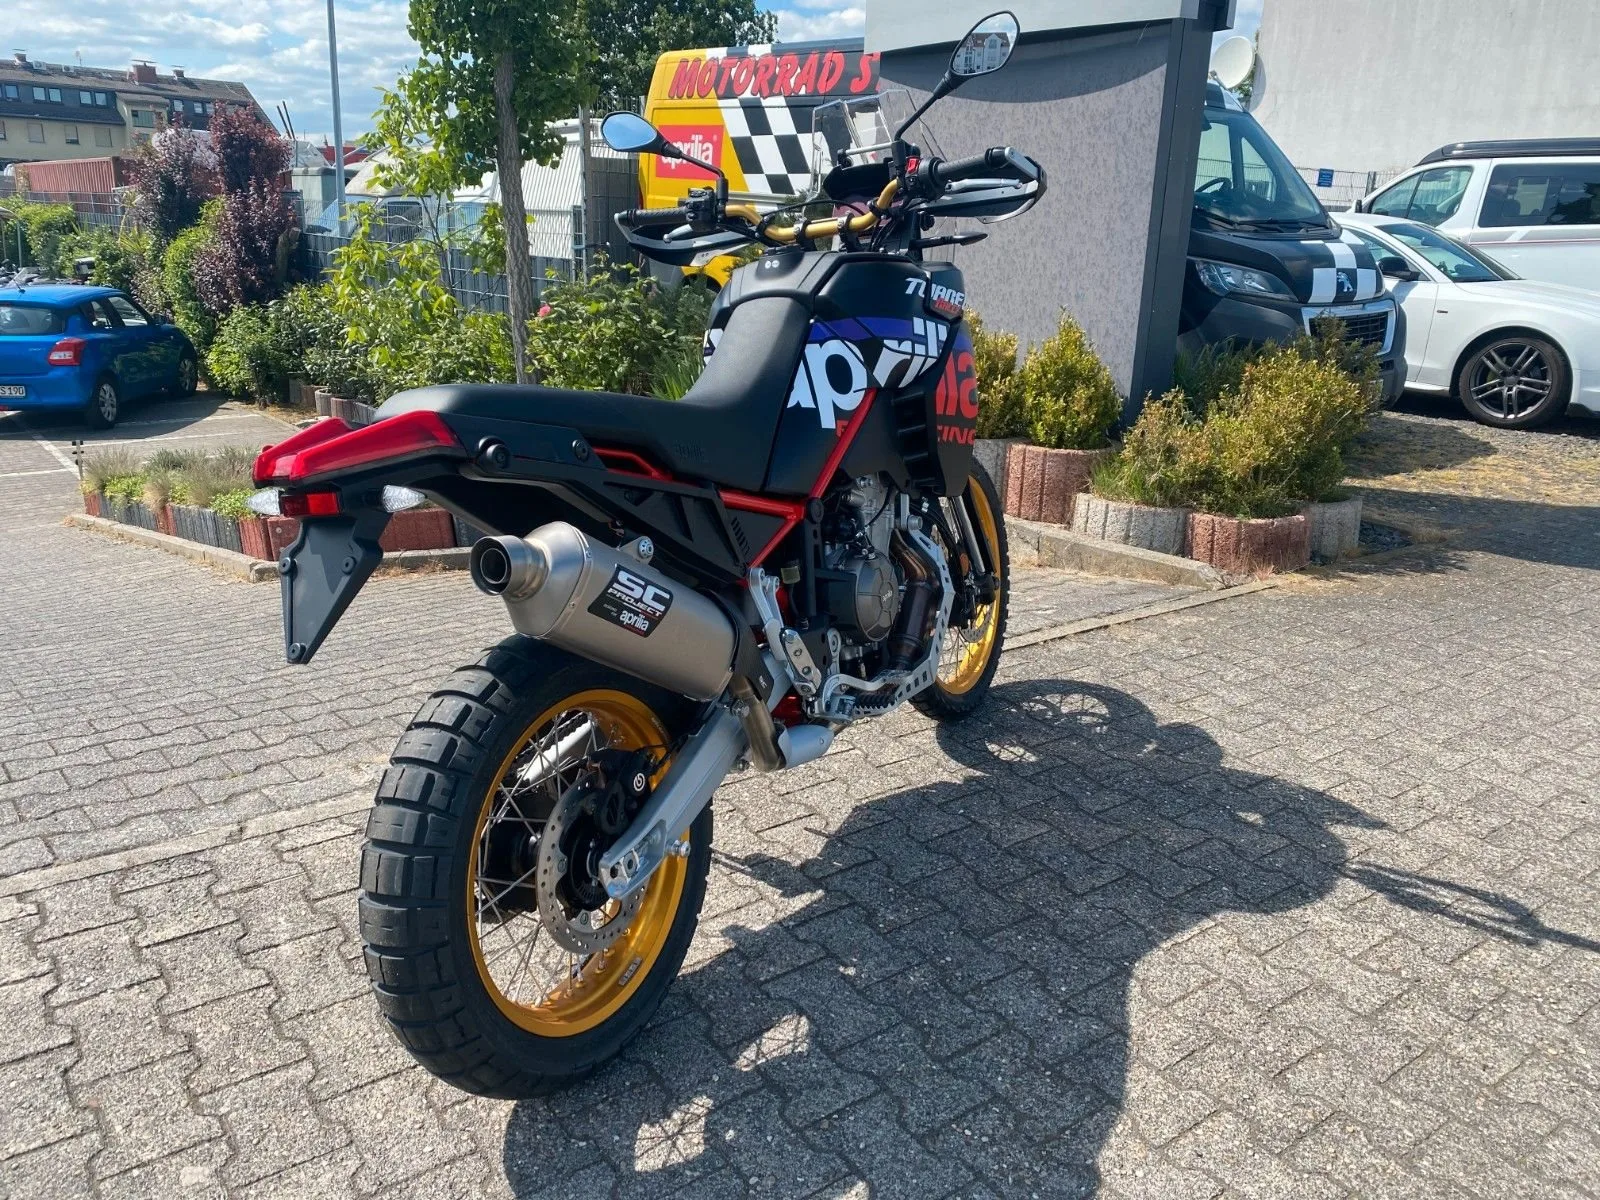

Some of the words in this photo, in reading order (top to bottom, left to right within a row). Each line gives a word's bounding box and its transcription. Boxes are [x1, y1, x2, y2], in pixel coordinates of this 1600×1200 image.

[668, 50, 845, 99] MOTORRAD
[850, 51, 881, 93] S
[905, 277, 966, 310] TUARE
[607, 588, 663, 617] PROJECT
[612, 570, 671, 612] SC
[620, 610, 649, 631] aprilia
